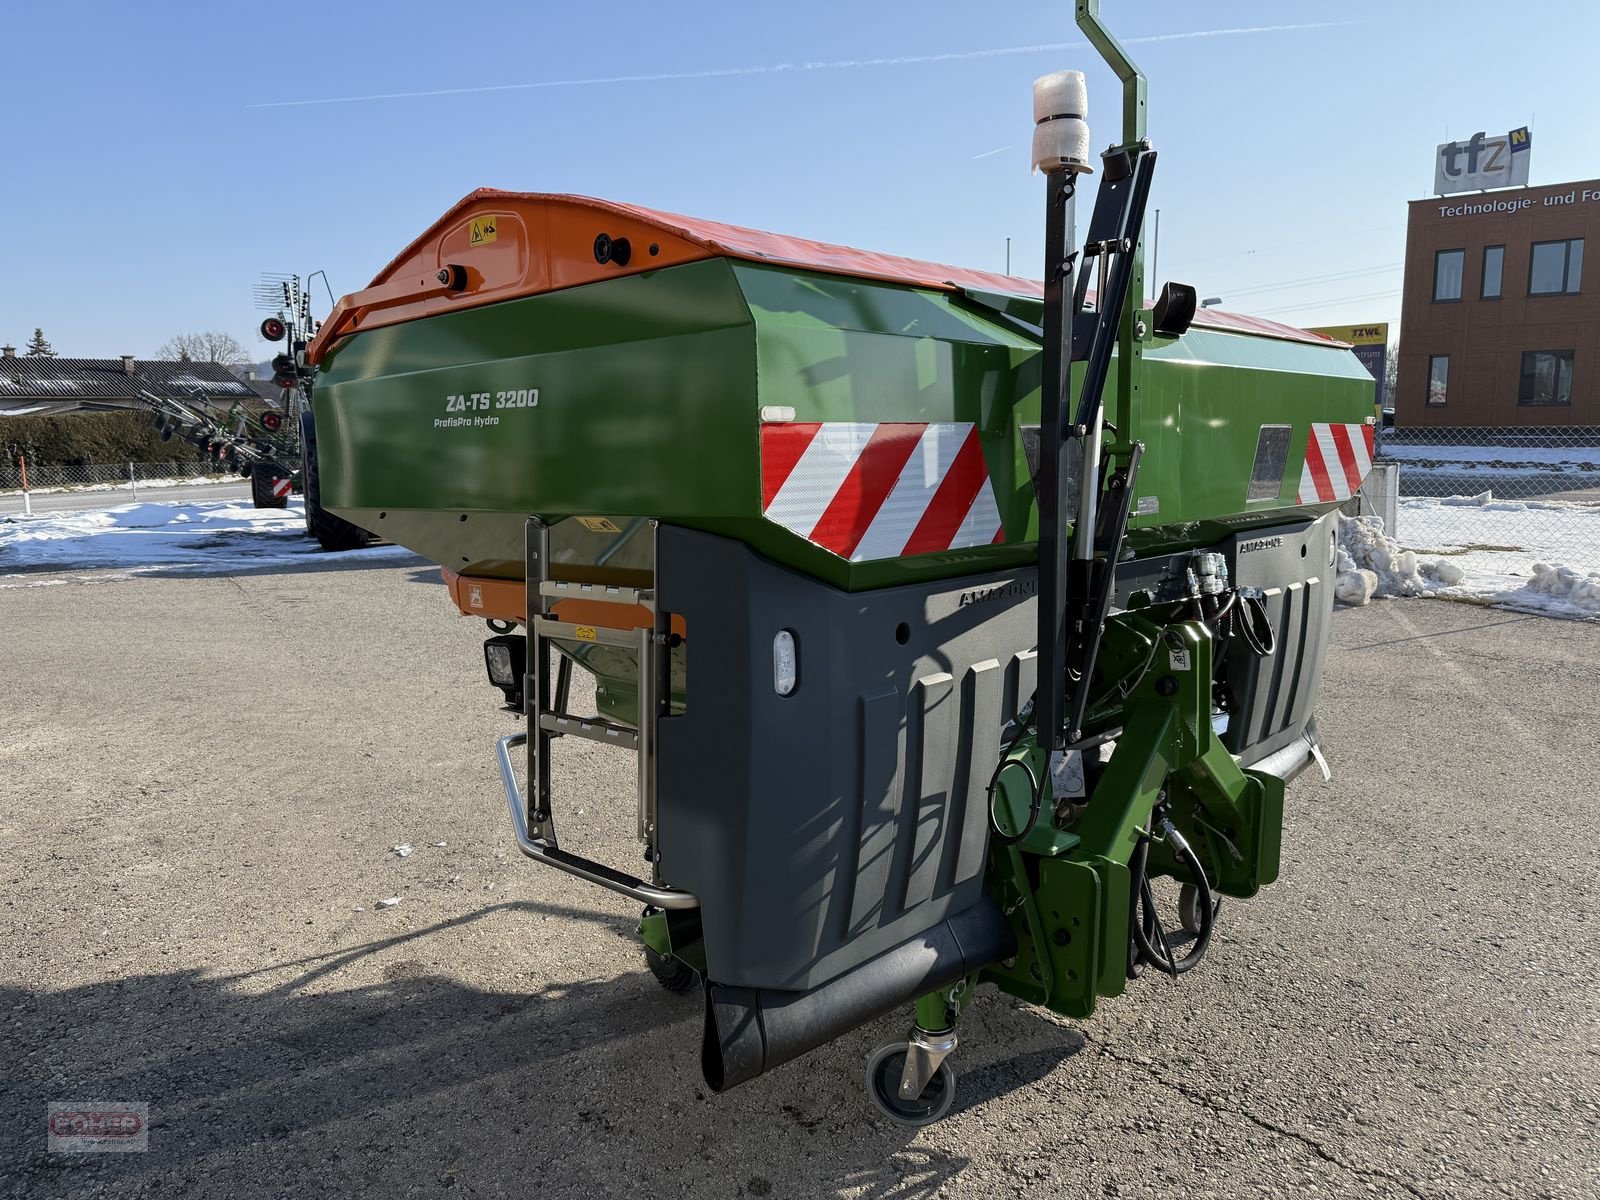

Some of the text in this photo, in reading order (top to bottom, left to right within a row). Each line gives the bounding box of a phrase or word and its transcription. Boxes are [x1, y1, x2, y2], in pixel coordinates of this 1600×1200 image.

[1511, 128, 1526, 145] N
[1441, 131, 1507, 176] tfz
[1438, 189, 1600, 218] Technologie- und Fo
[1353, 327, 1381, 338] TZWL
[1356, 350, 1381, 359] ntrum
[445, 388, 539, 412] ZA-TS 3200
[433, 415, 500, 428] ProfisPro Hydro
[1239, 536, 1284, 554] AMAZONE
[958, 580, 1036, 607] AMAZON
